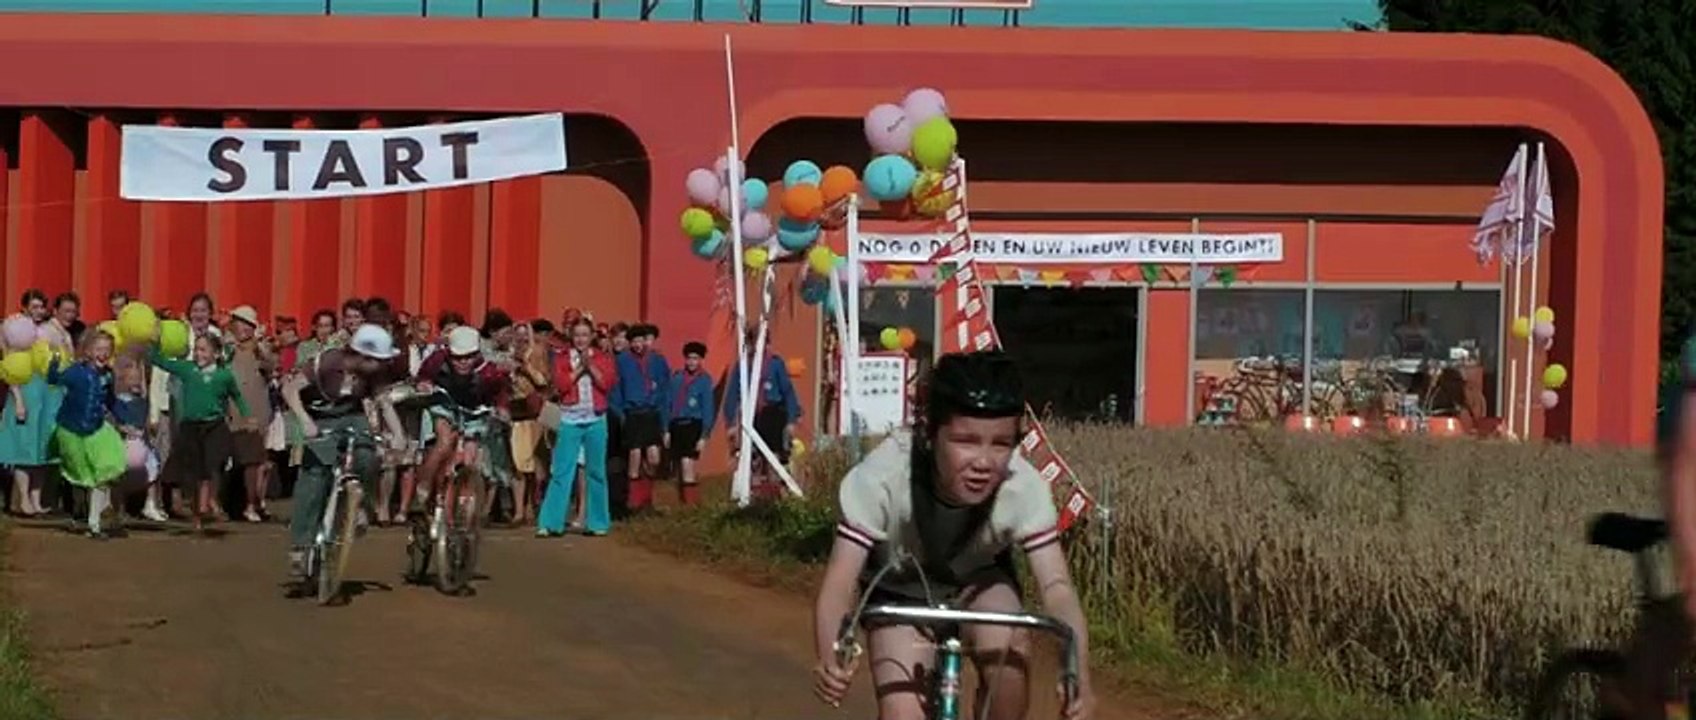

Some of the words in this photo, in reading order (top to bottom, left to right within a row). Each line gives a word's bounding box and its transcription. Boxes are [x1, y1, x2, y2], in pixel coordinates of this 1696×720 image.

[206, 131, 480, 194] START
[858, 239, 903, 255] NOG
[929, 239, 996, 255] DEN
[1003, 239, 1026, 255] EN
[1032, 239, 1064, 256] UW
[1139, 238, 1194, 255] LEVEN
